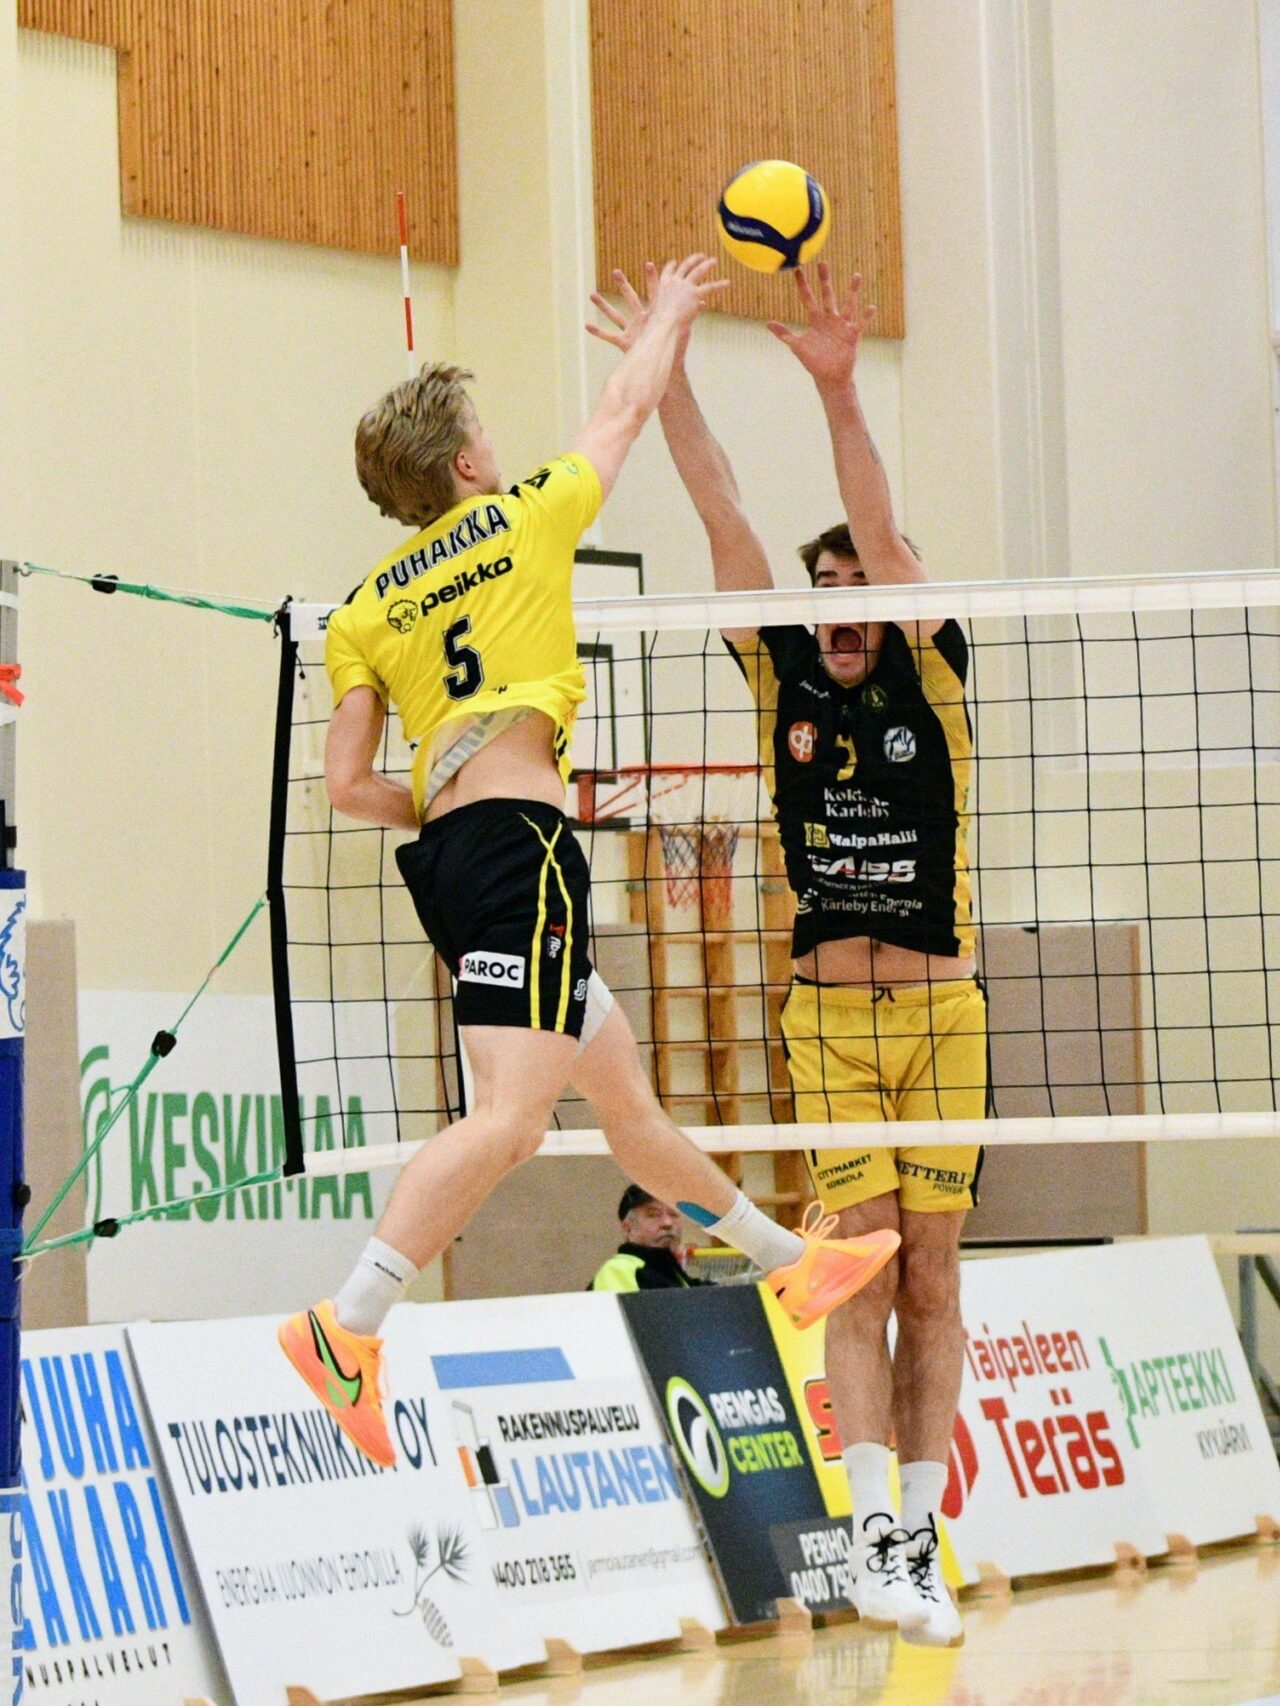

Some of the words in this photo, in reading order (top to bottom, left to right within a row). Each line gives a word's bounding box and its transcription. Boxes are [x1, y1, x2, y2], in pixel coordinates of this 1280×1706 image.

[374, 503, 511, 600] PUHAKKA
[420, 555, 513, 616] peikko
[442, 615, 484, 702] 5
[464, 960, 520, 981] PAROC
[21, 1350, 150, 1480] JUHA
[708, 1387, 787, 1429] RENGAS
[1130, 1347, 1237, 1418] APTEEKKI
[168, 1409, 397, 1495] TULOSTEKNIIK
[394, 1397, 437, 1470] OY
[498, 1404, 640, 1442] RAKENNUSPALVELU
[727, 1430, 804, 1474] CENTER
[979, 1388, 1125, 1498] Teräs
[511, 1443, 683, 1516] LAUTANEN
[22, 1476, 191, 1651] AKARI
[526, 1556, 551, 1585] 218
[551, 1554, 576, 1581] 365
[26, 1643, 171, 1689] NUSPALVELUT
